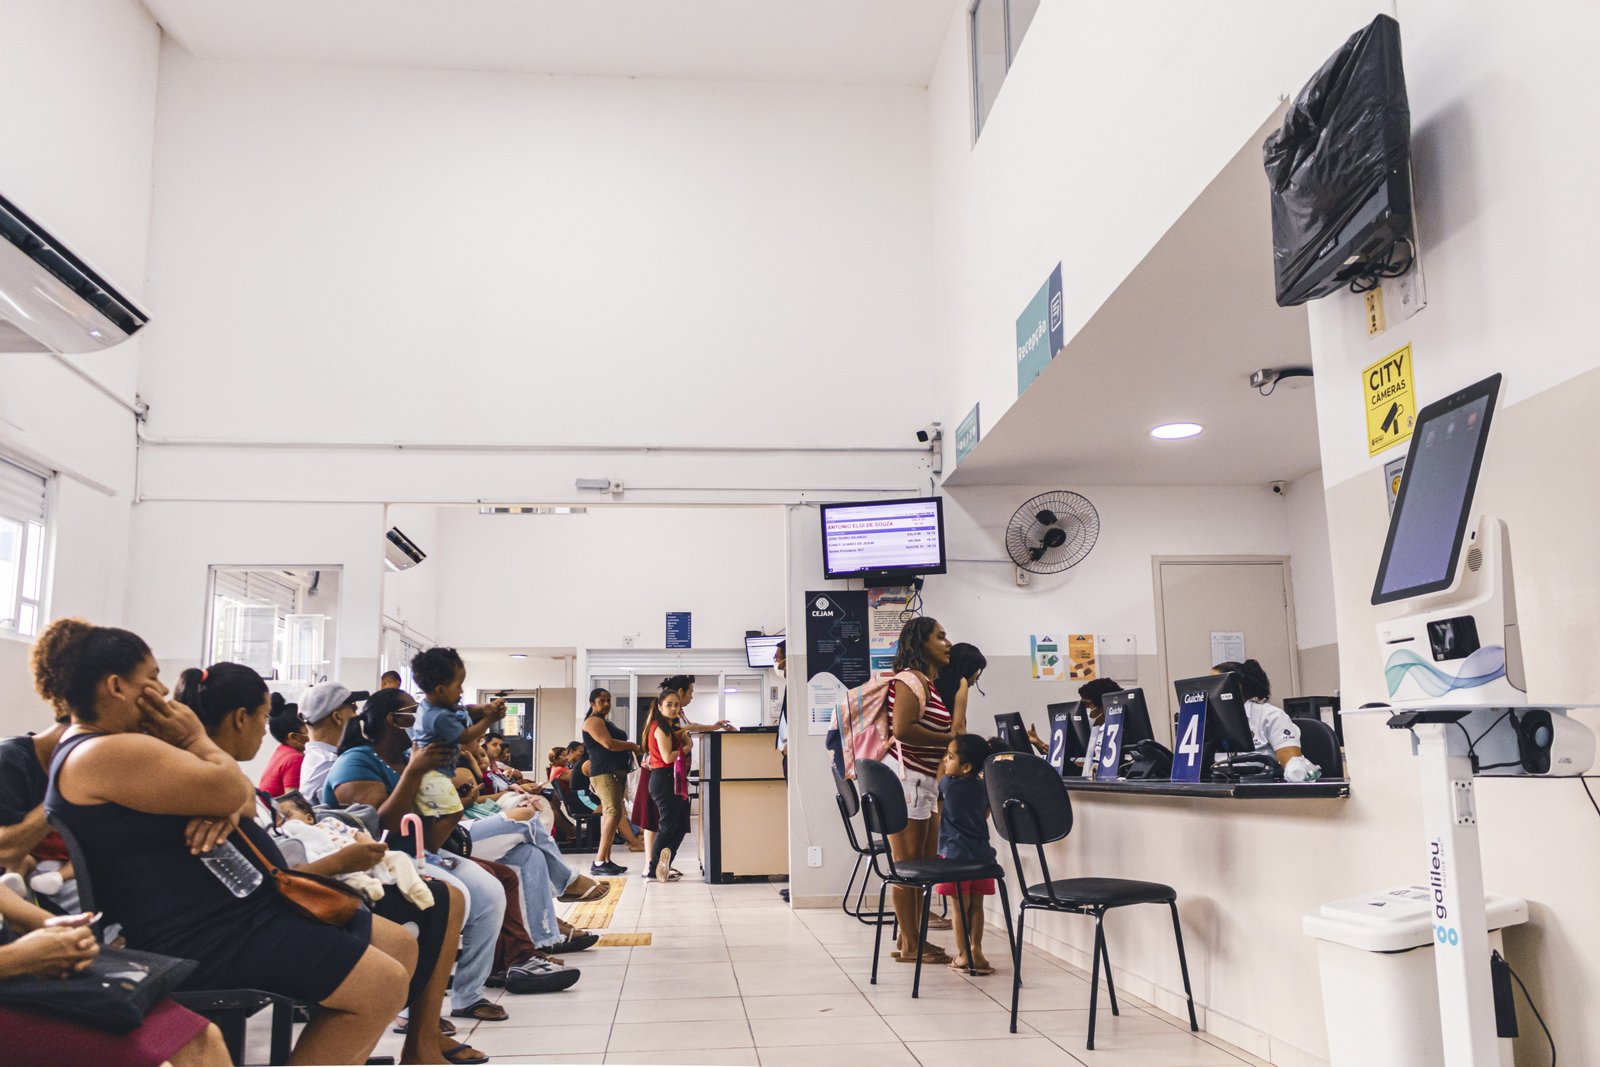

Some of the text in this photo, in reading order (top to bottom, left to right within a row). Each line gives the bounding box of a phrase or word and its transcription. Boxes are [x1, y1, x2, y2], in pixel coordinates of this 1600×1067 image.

[1018, 319, 1047, 361] Recepção
[1369, 354, 1404, 391] CITY
[1371, 379, 1406, 405] CÂMERAS
[1184, 691, 1205, 704] Guichê
[1051, 728, 1064, 768] 2
[1102, 723, 1119, 768] 3
[1178, 714, 1200, 767] 4
[1430, 842, 1447, 919] galileu
